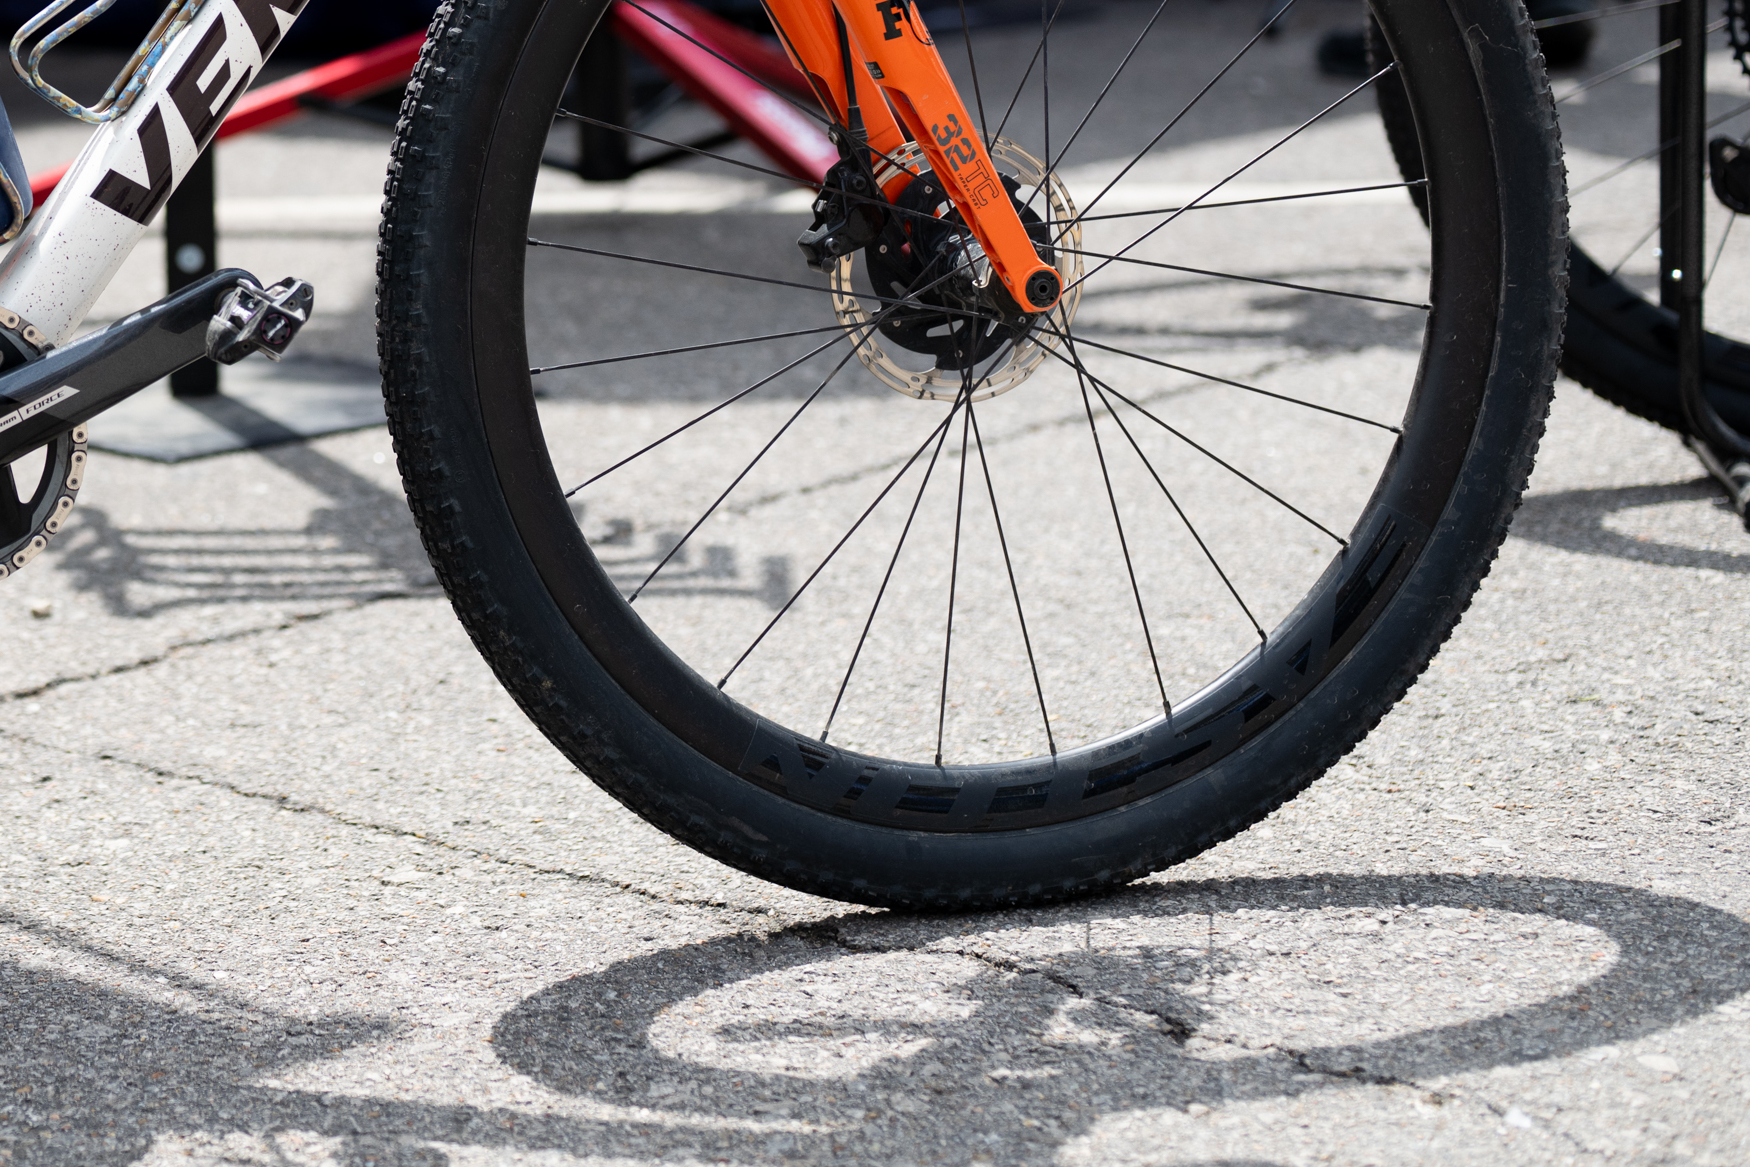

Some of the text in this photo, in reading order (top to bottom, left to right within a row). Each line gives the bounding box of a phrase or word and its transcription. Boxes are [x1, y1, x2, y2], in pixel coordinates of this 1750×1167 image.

[931, 113, 1001, 207] 32 TC
[25, 390, 65, 415] FORCE
